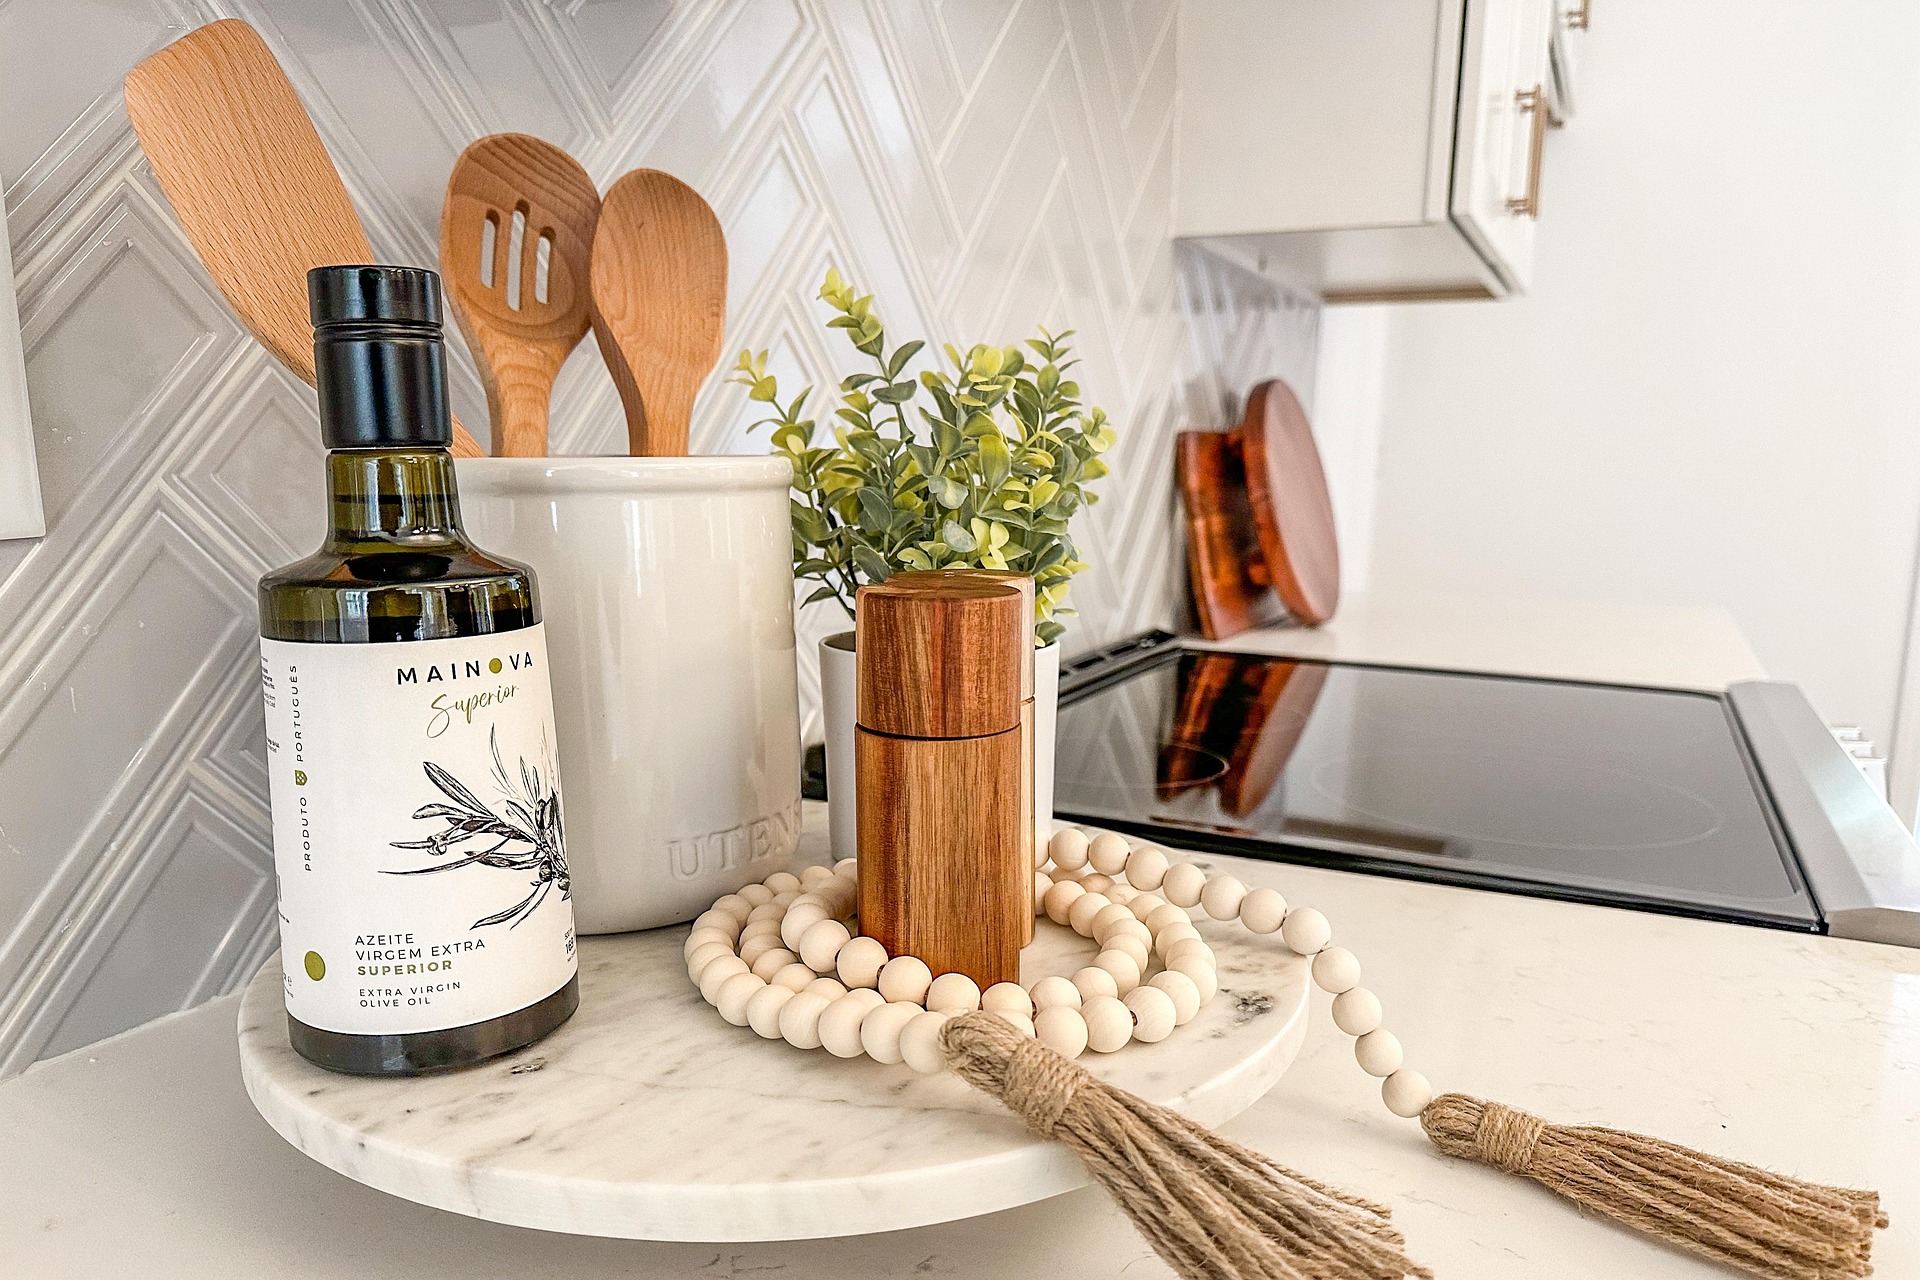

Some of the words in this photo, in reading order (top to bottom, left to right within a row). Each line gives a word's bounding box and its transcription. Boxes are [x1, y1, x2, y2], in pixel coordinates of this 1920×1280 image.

[397, 651, 533, 685] MAINOVA
[289, 664, 304, 763] PORTUGUÊS
[426, 684, 520, 739] Superior
[299, 796, 312, 872] PRODUTO
[666, 797, 802, 881] UTEN
[355, 933, 414, 946] AZEITE
[355, 948, 422, 961] VIRGEM
[431, 939, 486, 957] EXTRA
[357, 960, 453, 976] SUPERIOR
[359, 988, 403, 997] EXTRA
[409, 981, 461, 995] VIRGIN
[359, 999, 400, 1008] OLIVE
[407, 997, 431, 1006] OIL
